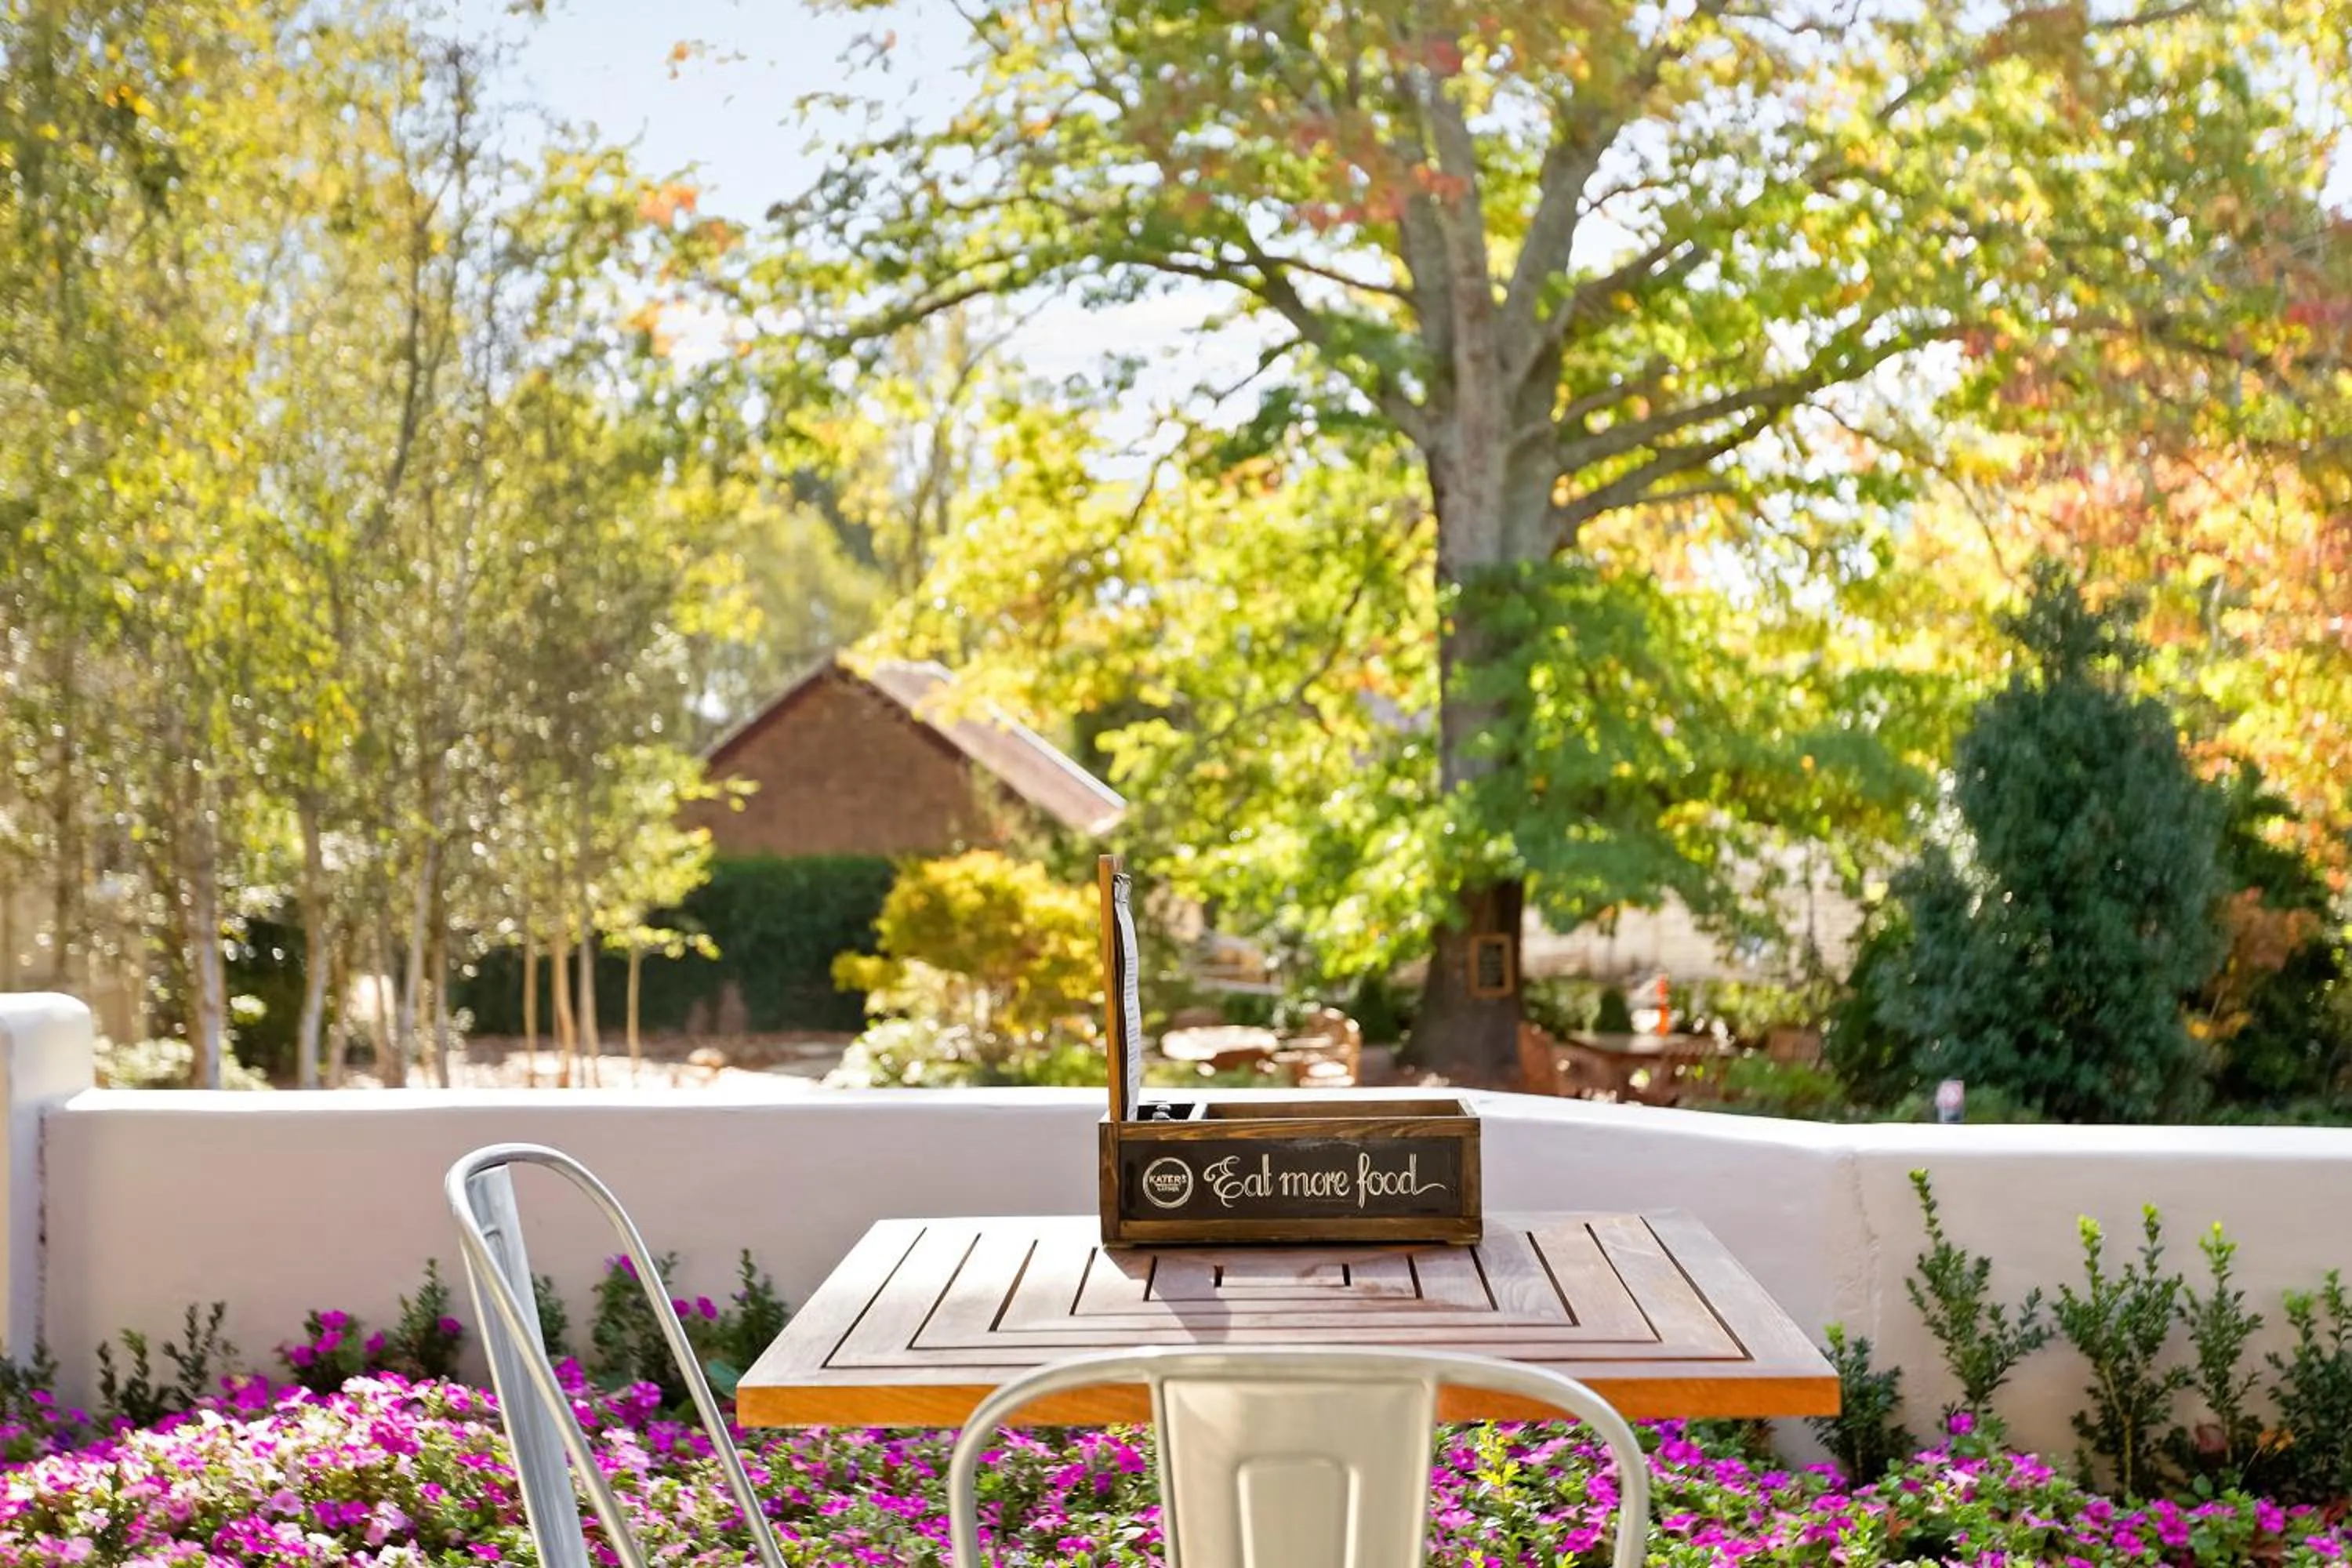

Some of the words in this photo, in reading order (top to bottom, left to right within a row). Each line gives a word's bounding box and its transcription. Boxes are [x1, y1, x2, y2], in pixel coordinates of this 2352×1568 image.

[1203, 1153, 1272, 1208] Eat
[1279, 1171, 1350, 1197] more
[1356, 1152, 1446, 1208] food
